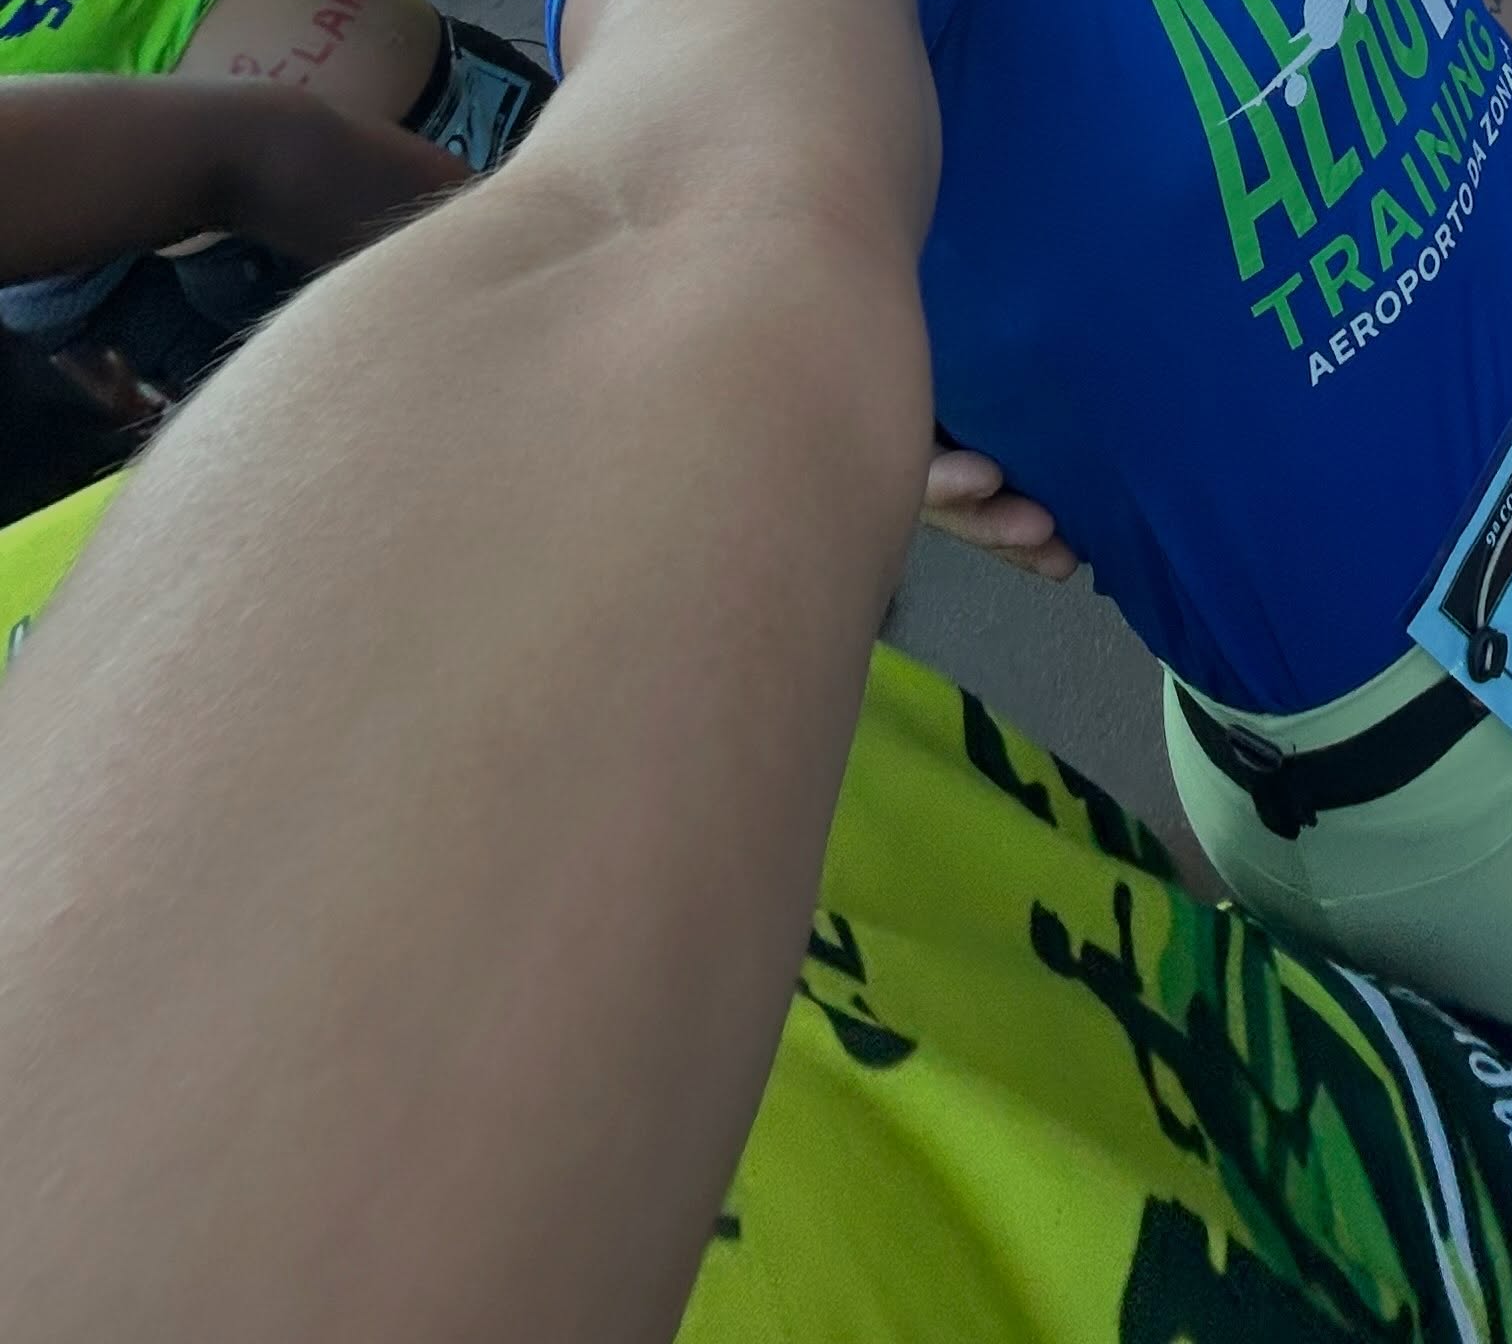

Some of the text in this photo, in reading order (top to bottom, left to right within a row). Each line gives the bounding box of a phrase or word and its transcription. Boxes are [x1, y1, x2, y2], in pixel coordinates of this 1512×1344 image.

[1250, 9, 1495, 350] TRAINING
[1307, 182, 1474, 387] AEROPORTO
[1467, 140, 1487, 189] DA
